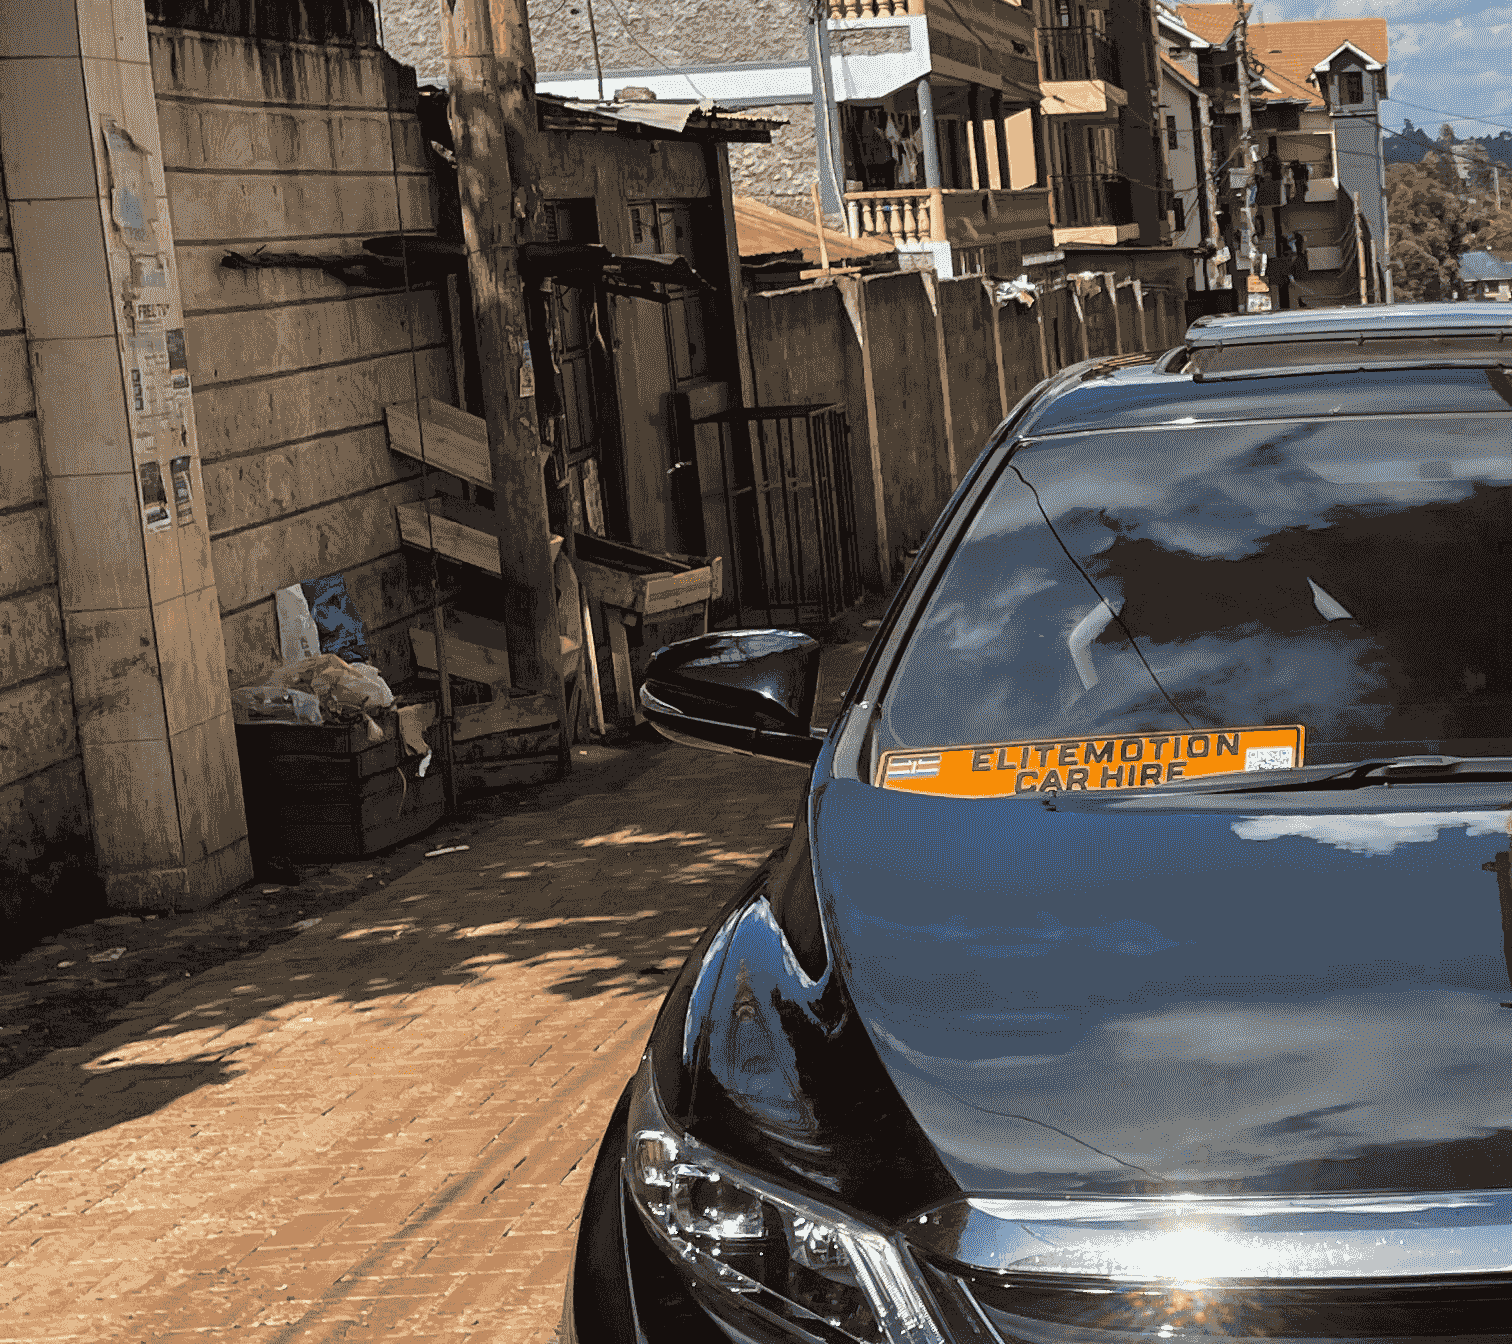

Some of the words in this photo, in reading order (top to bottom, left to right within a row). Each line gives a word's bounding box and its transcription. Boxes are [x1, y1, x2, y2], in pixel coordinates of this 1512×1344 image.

[971, 732, 1241, 772] ELITEMOTION
[1014, 767, 1089, 793] CAR
[1100, 761, 1187, 789] HIRE
